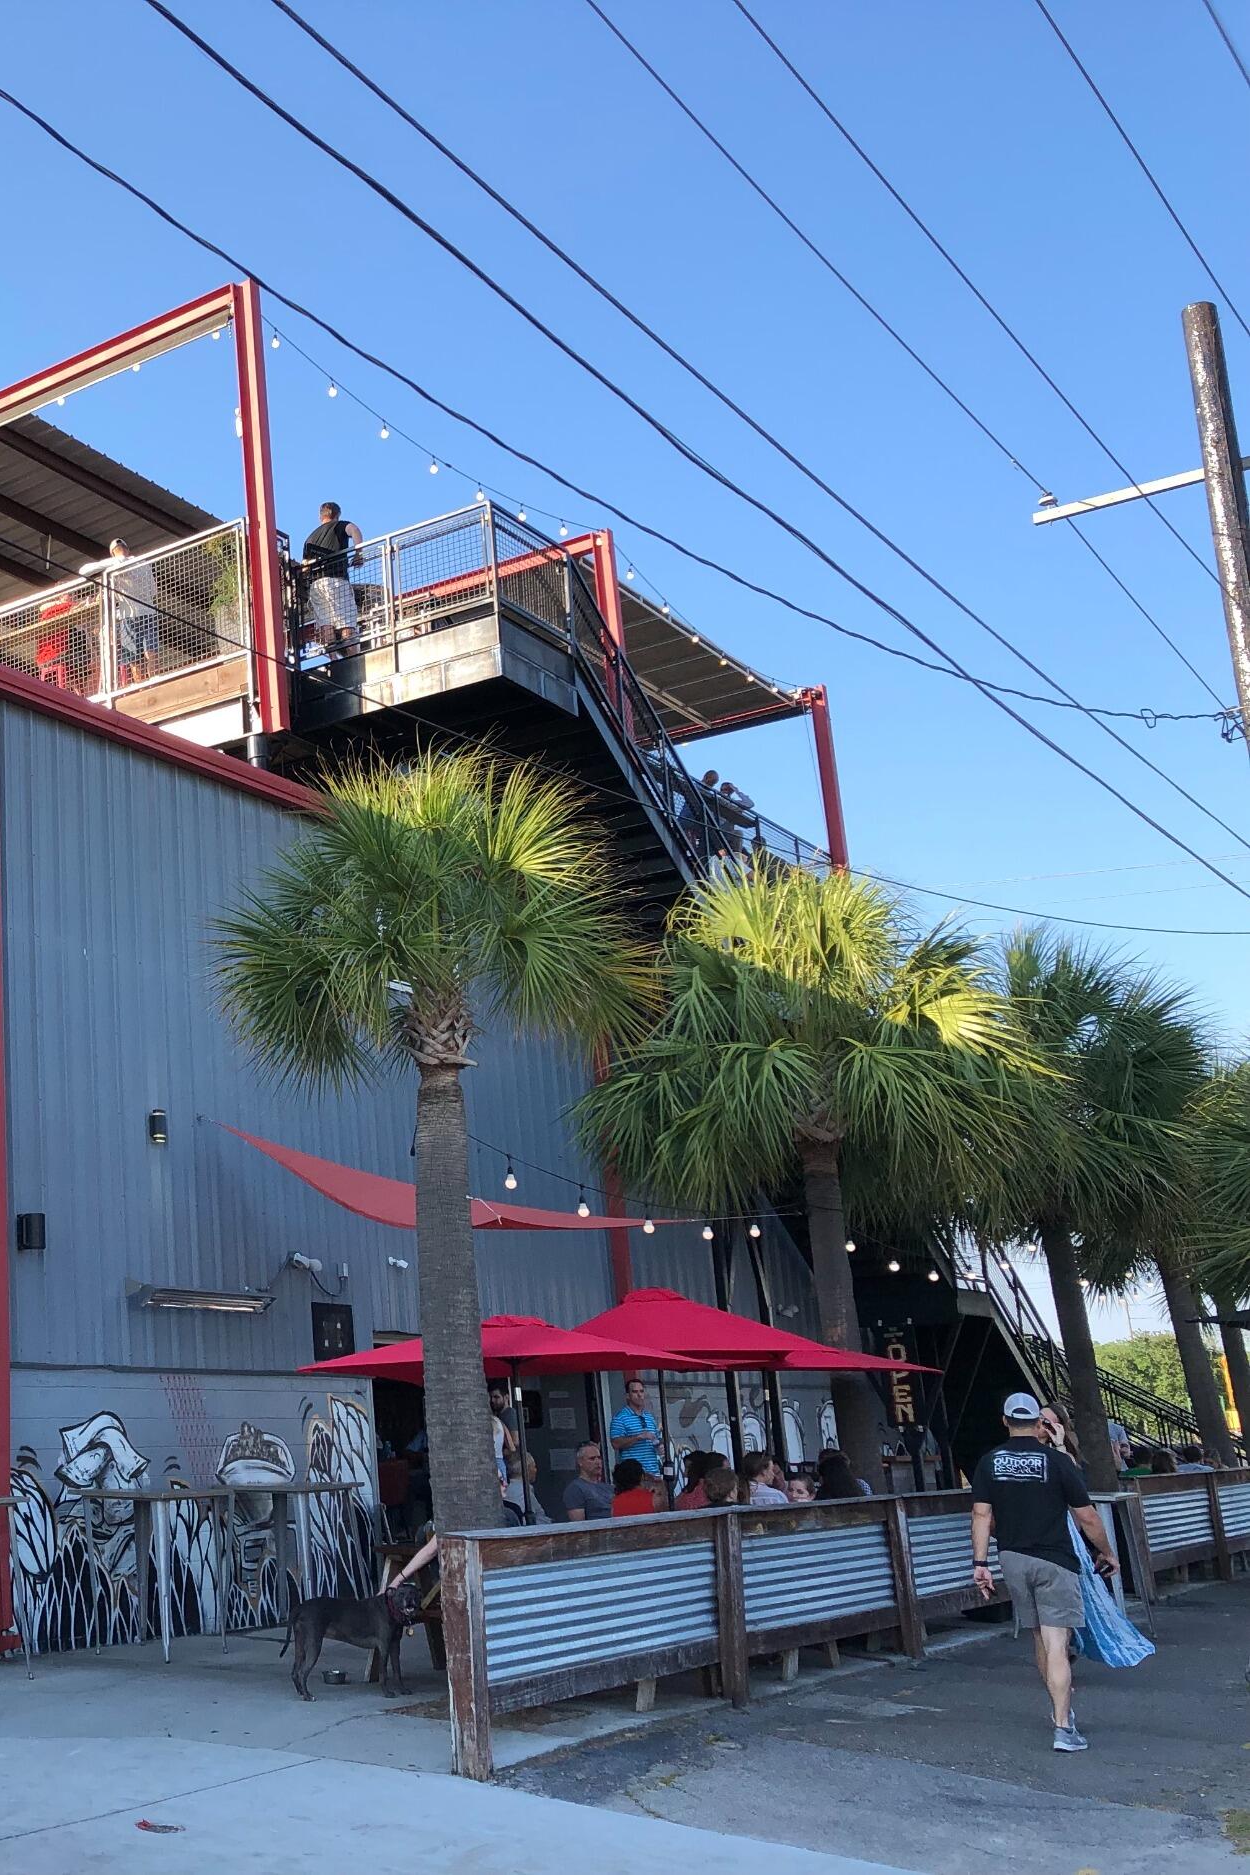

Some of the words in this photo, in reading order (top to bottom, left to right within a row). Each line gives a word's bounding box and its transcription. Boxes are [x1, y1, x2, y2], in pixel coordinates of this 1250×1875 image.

[887, 1344, 915, 1423] OPEN
[993, 1456, 1042, 1468] OUTDOOR
[994, 1464, 1043, 1474] RESEARCH
